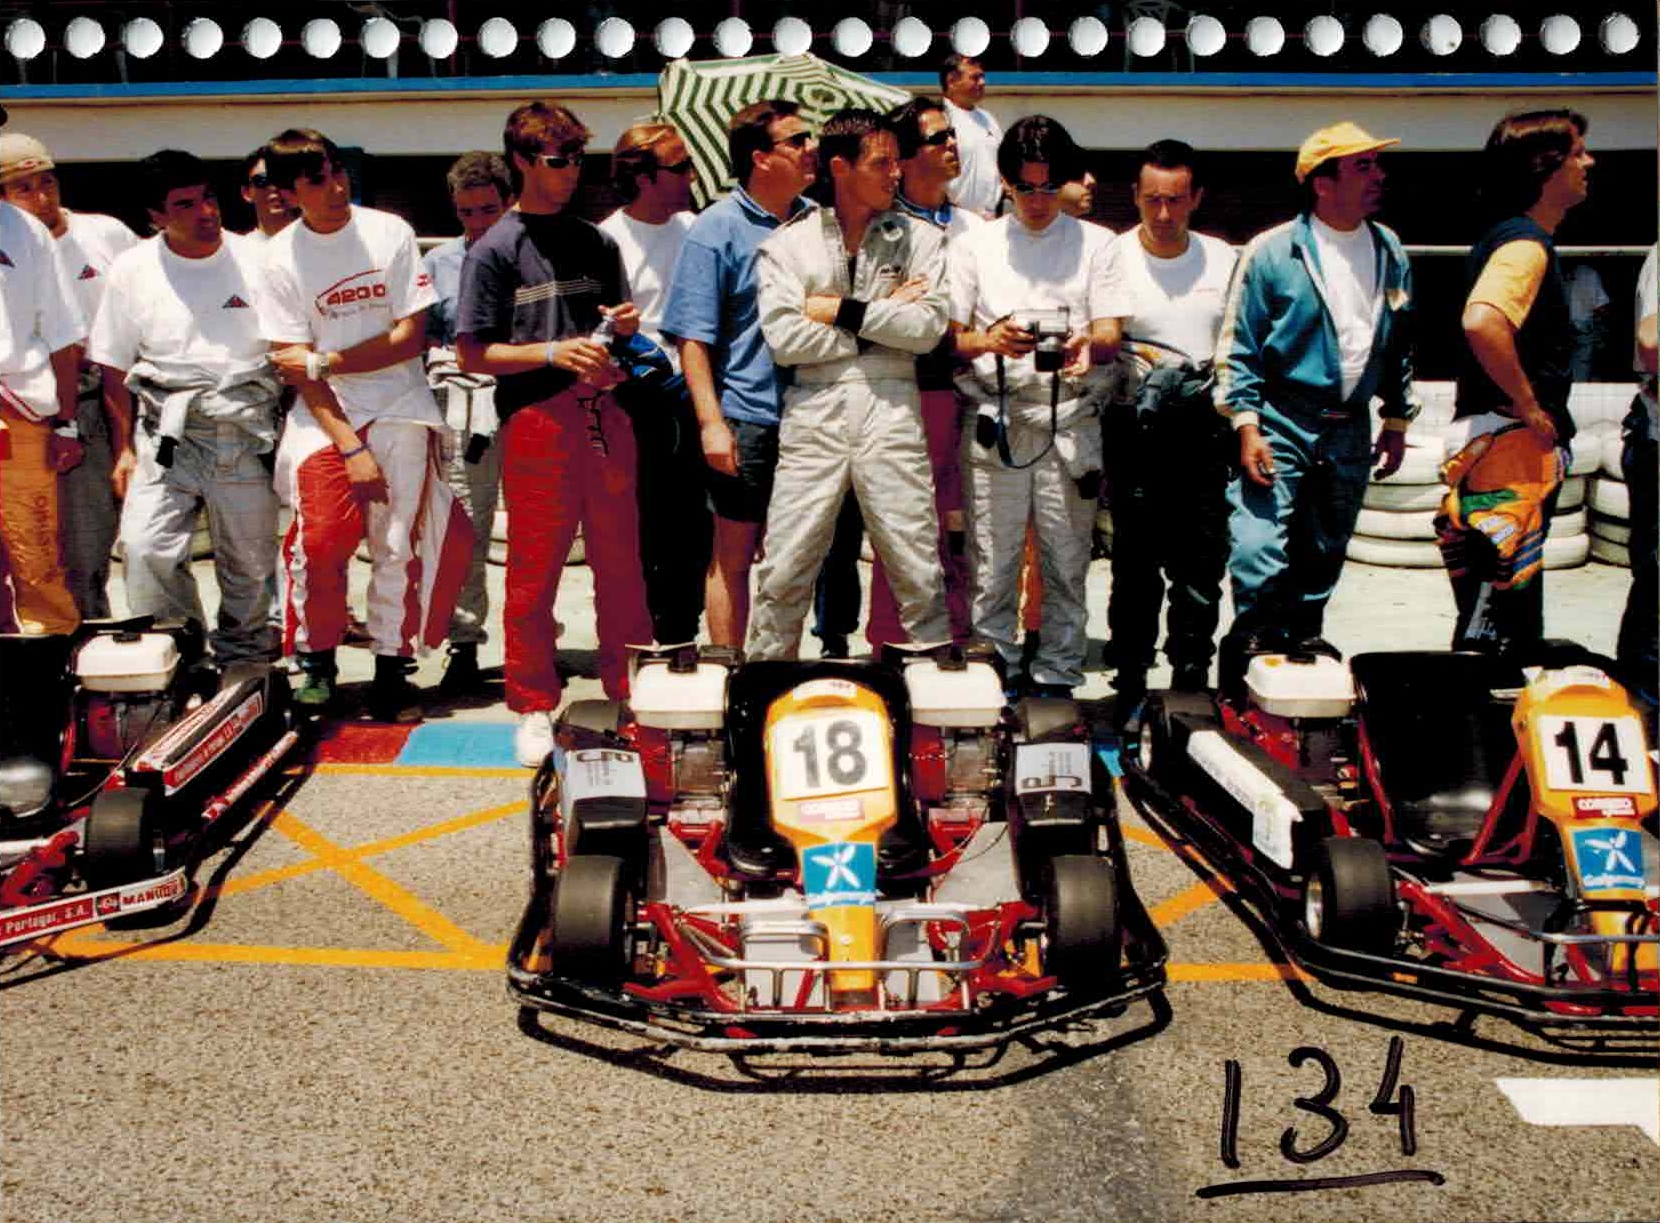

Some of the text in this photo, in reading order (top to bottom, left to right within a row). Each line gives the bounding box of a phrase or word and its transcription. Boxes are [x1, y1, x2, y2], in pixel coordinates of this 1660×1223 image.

[792, 719, 868, 788] 18
[1554, 721, 1629, 785] 14
[1221, 1036, 1417, 1169] 134
